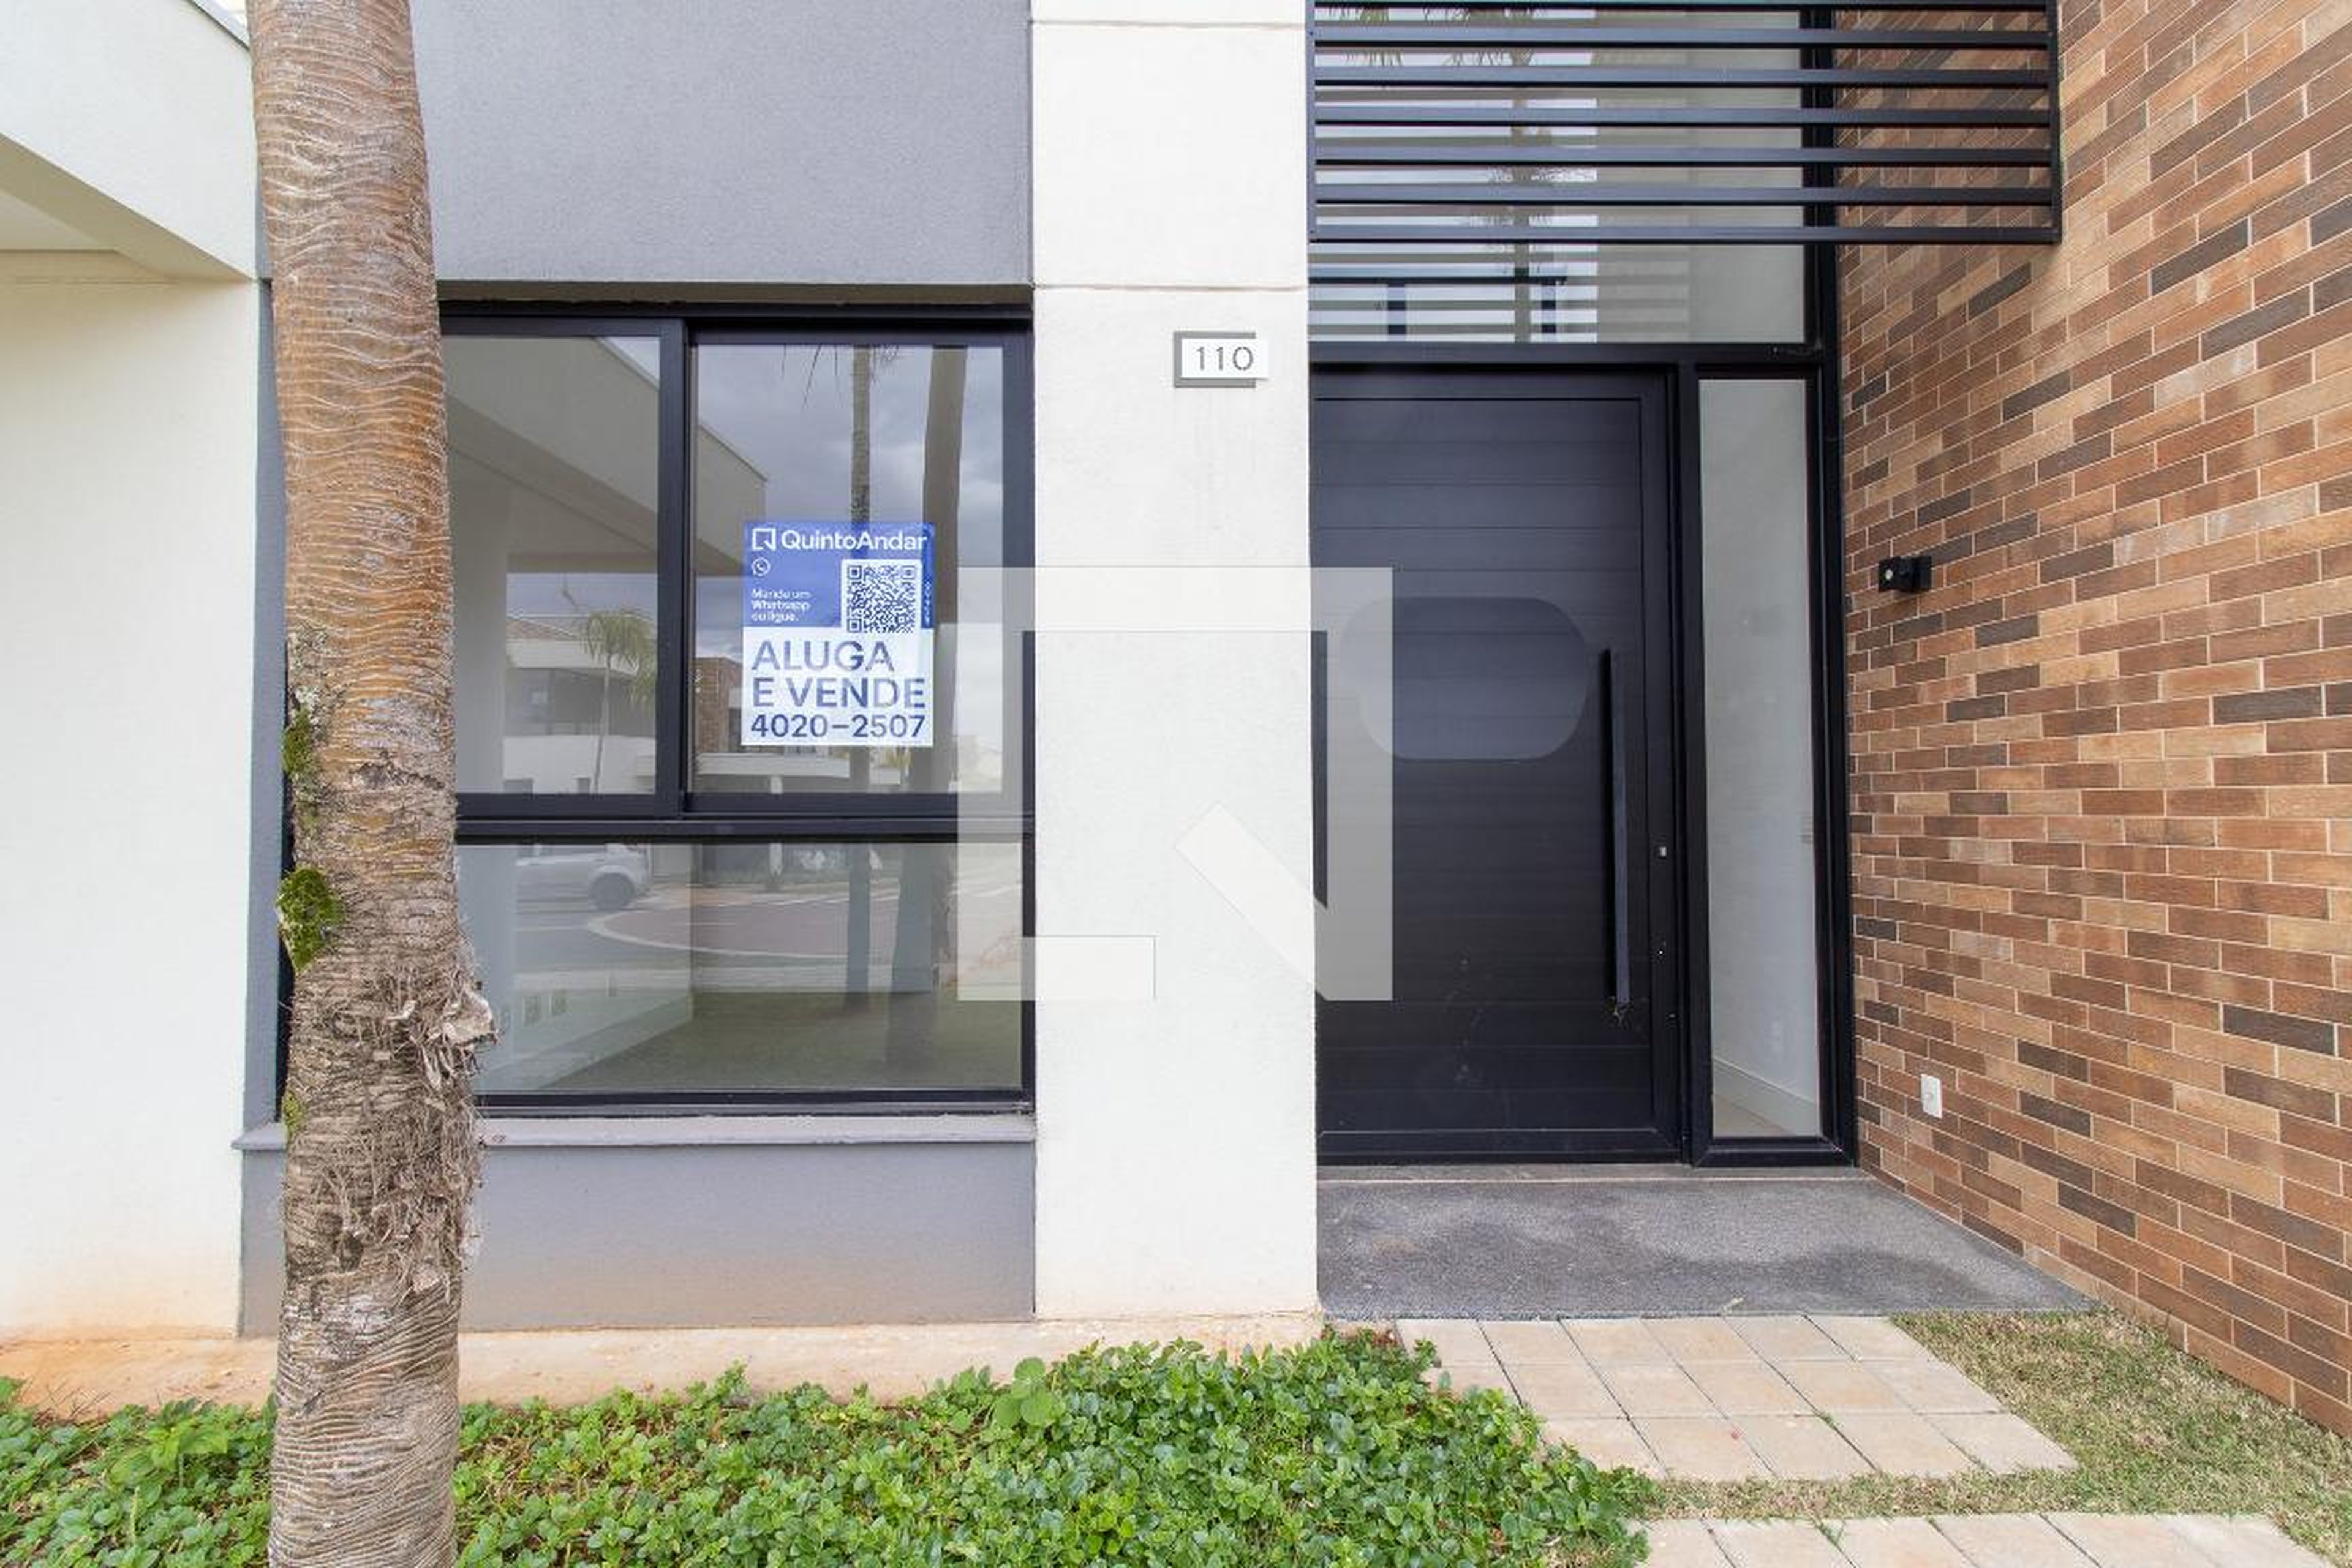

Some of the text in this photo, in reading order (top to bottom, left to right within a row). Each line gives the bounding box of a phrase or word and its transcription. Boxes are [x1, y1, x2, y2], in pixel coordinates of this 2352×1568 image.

[1196, 346, 1253, 371] 110
[781, 529, 927, 550] QuintoAndar
[751, 641, 894, 671] ALUGA
[753, 678, 926, 708] E VENDE
[751, 714, 925, 738] 4020-2507
